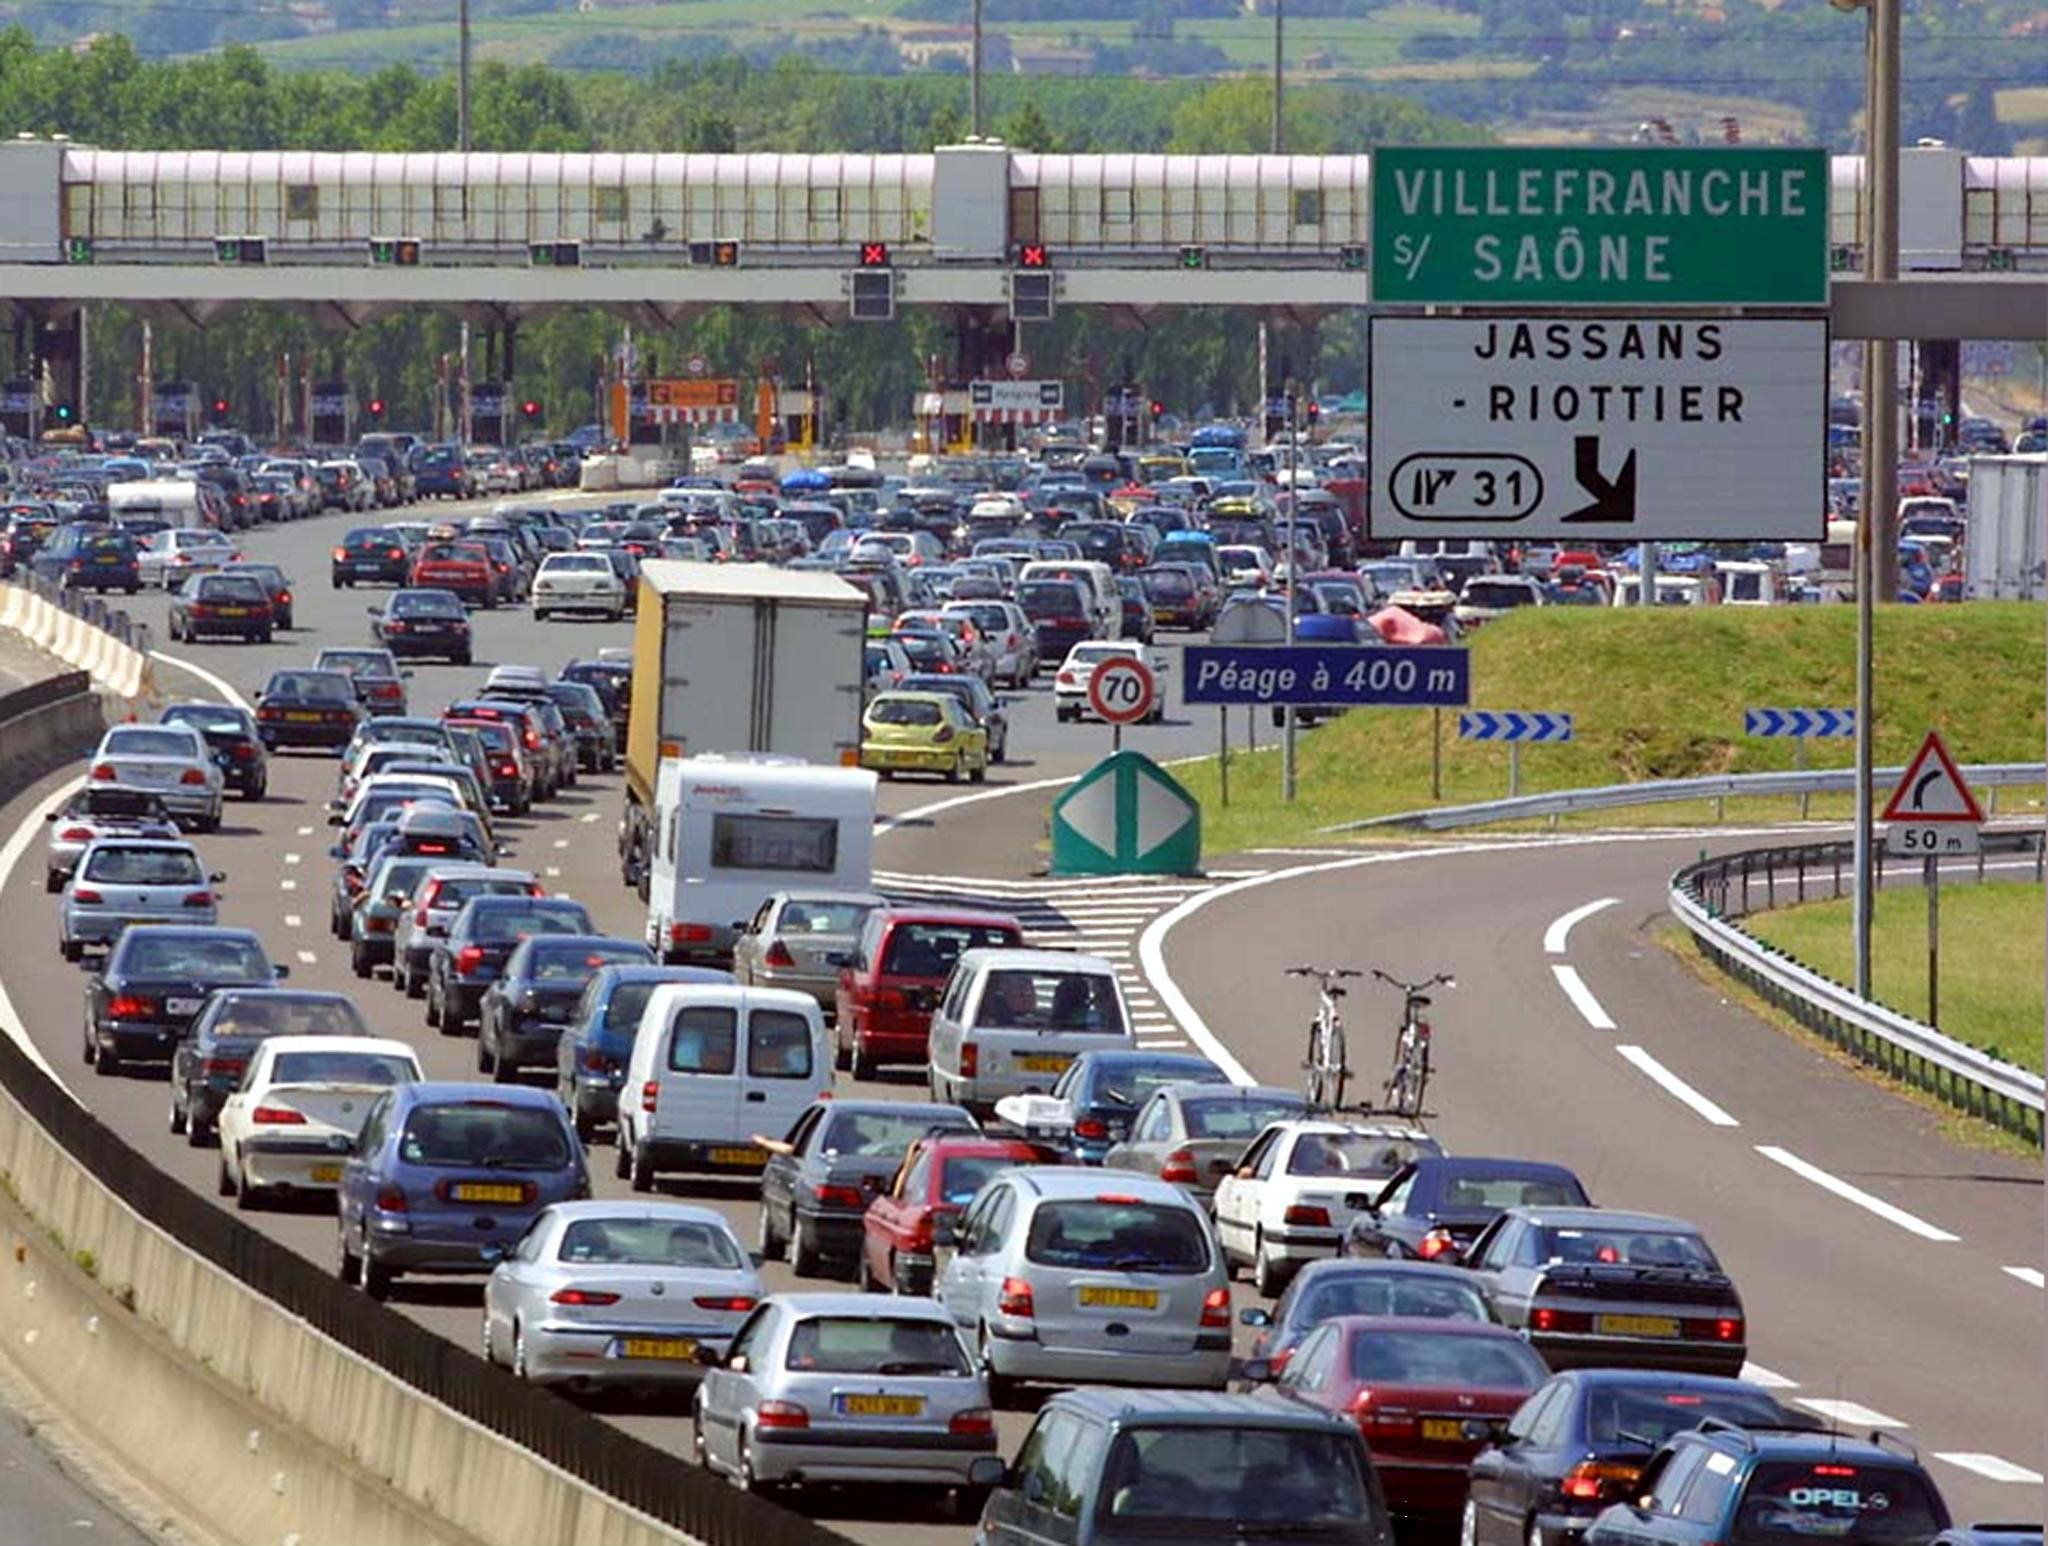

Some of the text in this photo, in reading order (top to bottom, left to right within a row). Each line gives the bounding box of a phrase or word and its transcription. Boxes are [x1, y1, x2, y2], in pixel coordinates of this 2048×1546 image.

[1393, 169, 1807, 217] VILLEFRANCHE
[1473, 226, 1673, 282] SAÔNE
[1474, 323, 1723, 361] JASSANS
[1473, 471, 1522, 506] 31
[1103, 675, 1141, 702] 70
[1196, 659, 1456, 699] Péage à 400 m
[1904, 829, 1962, 849] 50 m
[1789, 1487, 1868, 1509] OPEL
